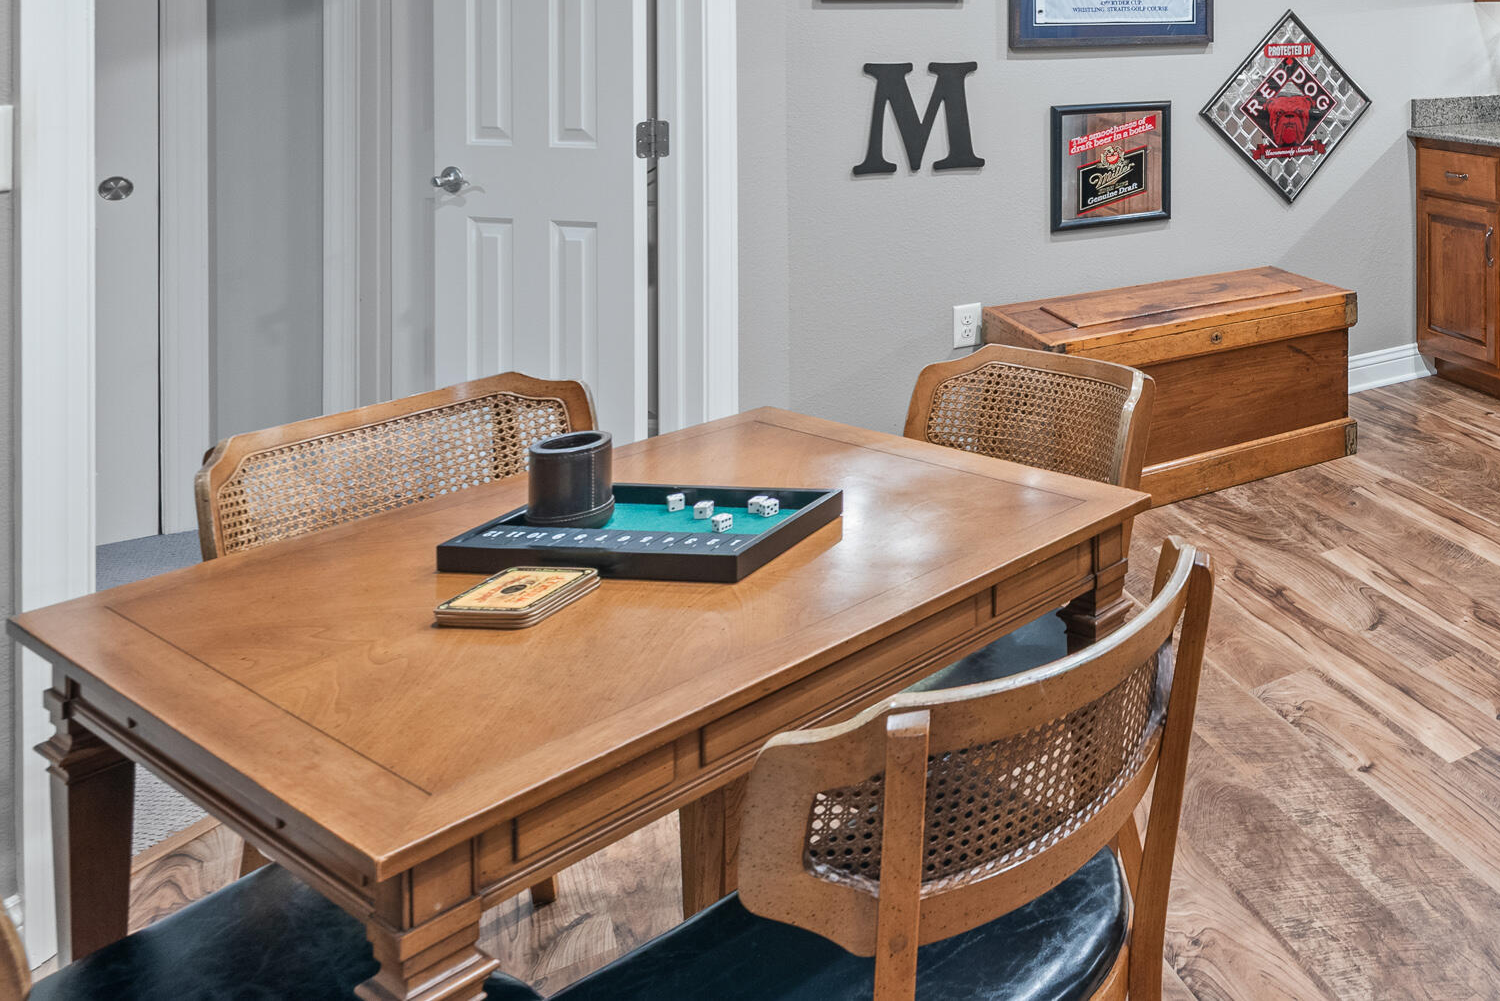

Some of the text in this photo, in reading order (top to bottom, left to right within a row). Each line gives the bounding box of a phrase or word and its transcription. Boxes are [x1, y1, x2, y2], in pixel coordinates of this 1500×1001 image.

[1267, 45, 1312, 56] PROTECTED BY
[1246, 67, 1330, 117] RED DOG
[852, 61, 986, 176] M
[1071, 116, 1147, 146] The smoothness of
[1070, 141, 1094, 154] draft
[1093, 136, 1112, 147] beer
[1113, 133, 1122, 141] in
[1088, 162, 1136, 190] Miller
[1087, 190, 1118, 205] Genuine
[1118, 182, 1138, 195] Draft
